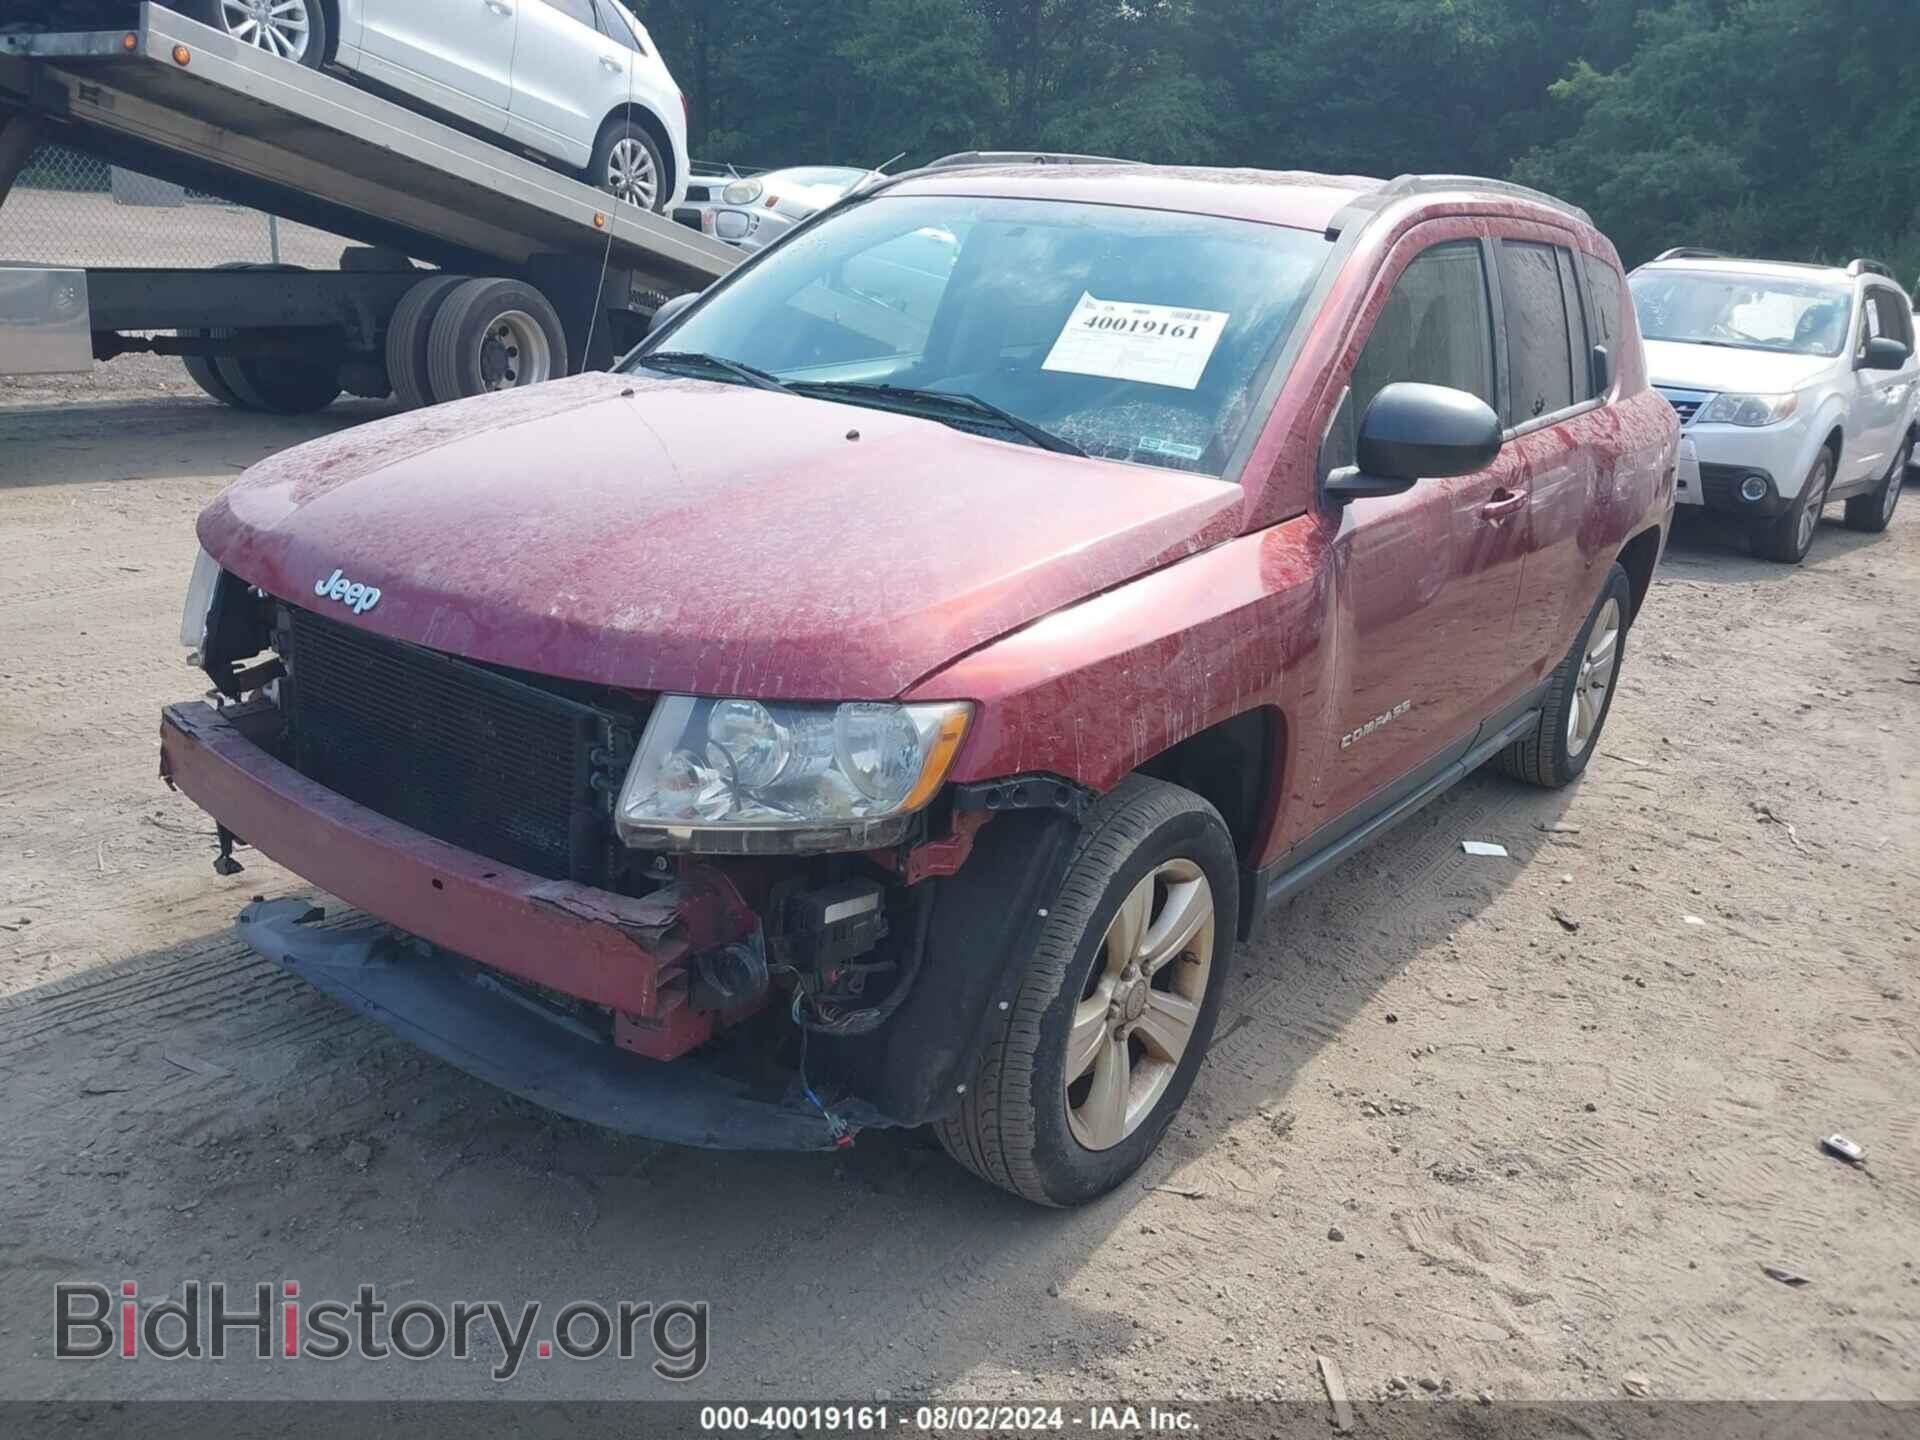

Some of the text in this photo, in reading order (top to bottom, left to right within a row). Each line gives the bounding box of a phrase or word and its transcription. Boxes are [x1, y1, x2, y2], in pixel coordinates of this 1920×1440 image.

[1083, 315, 1200, 339] 40019161
[314, 568, 381, 615] Jeep
[1340, 699, 1411, 750] COMPASS
